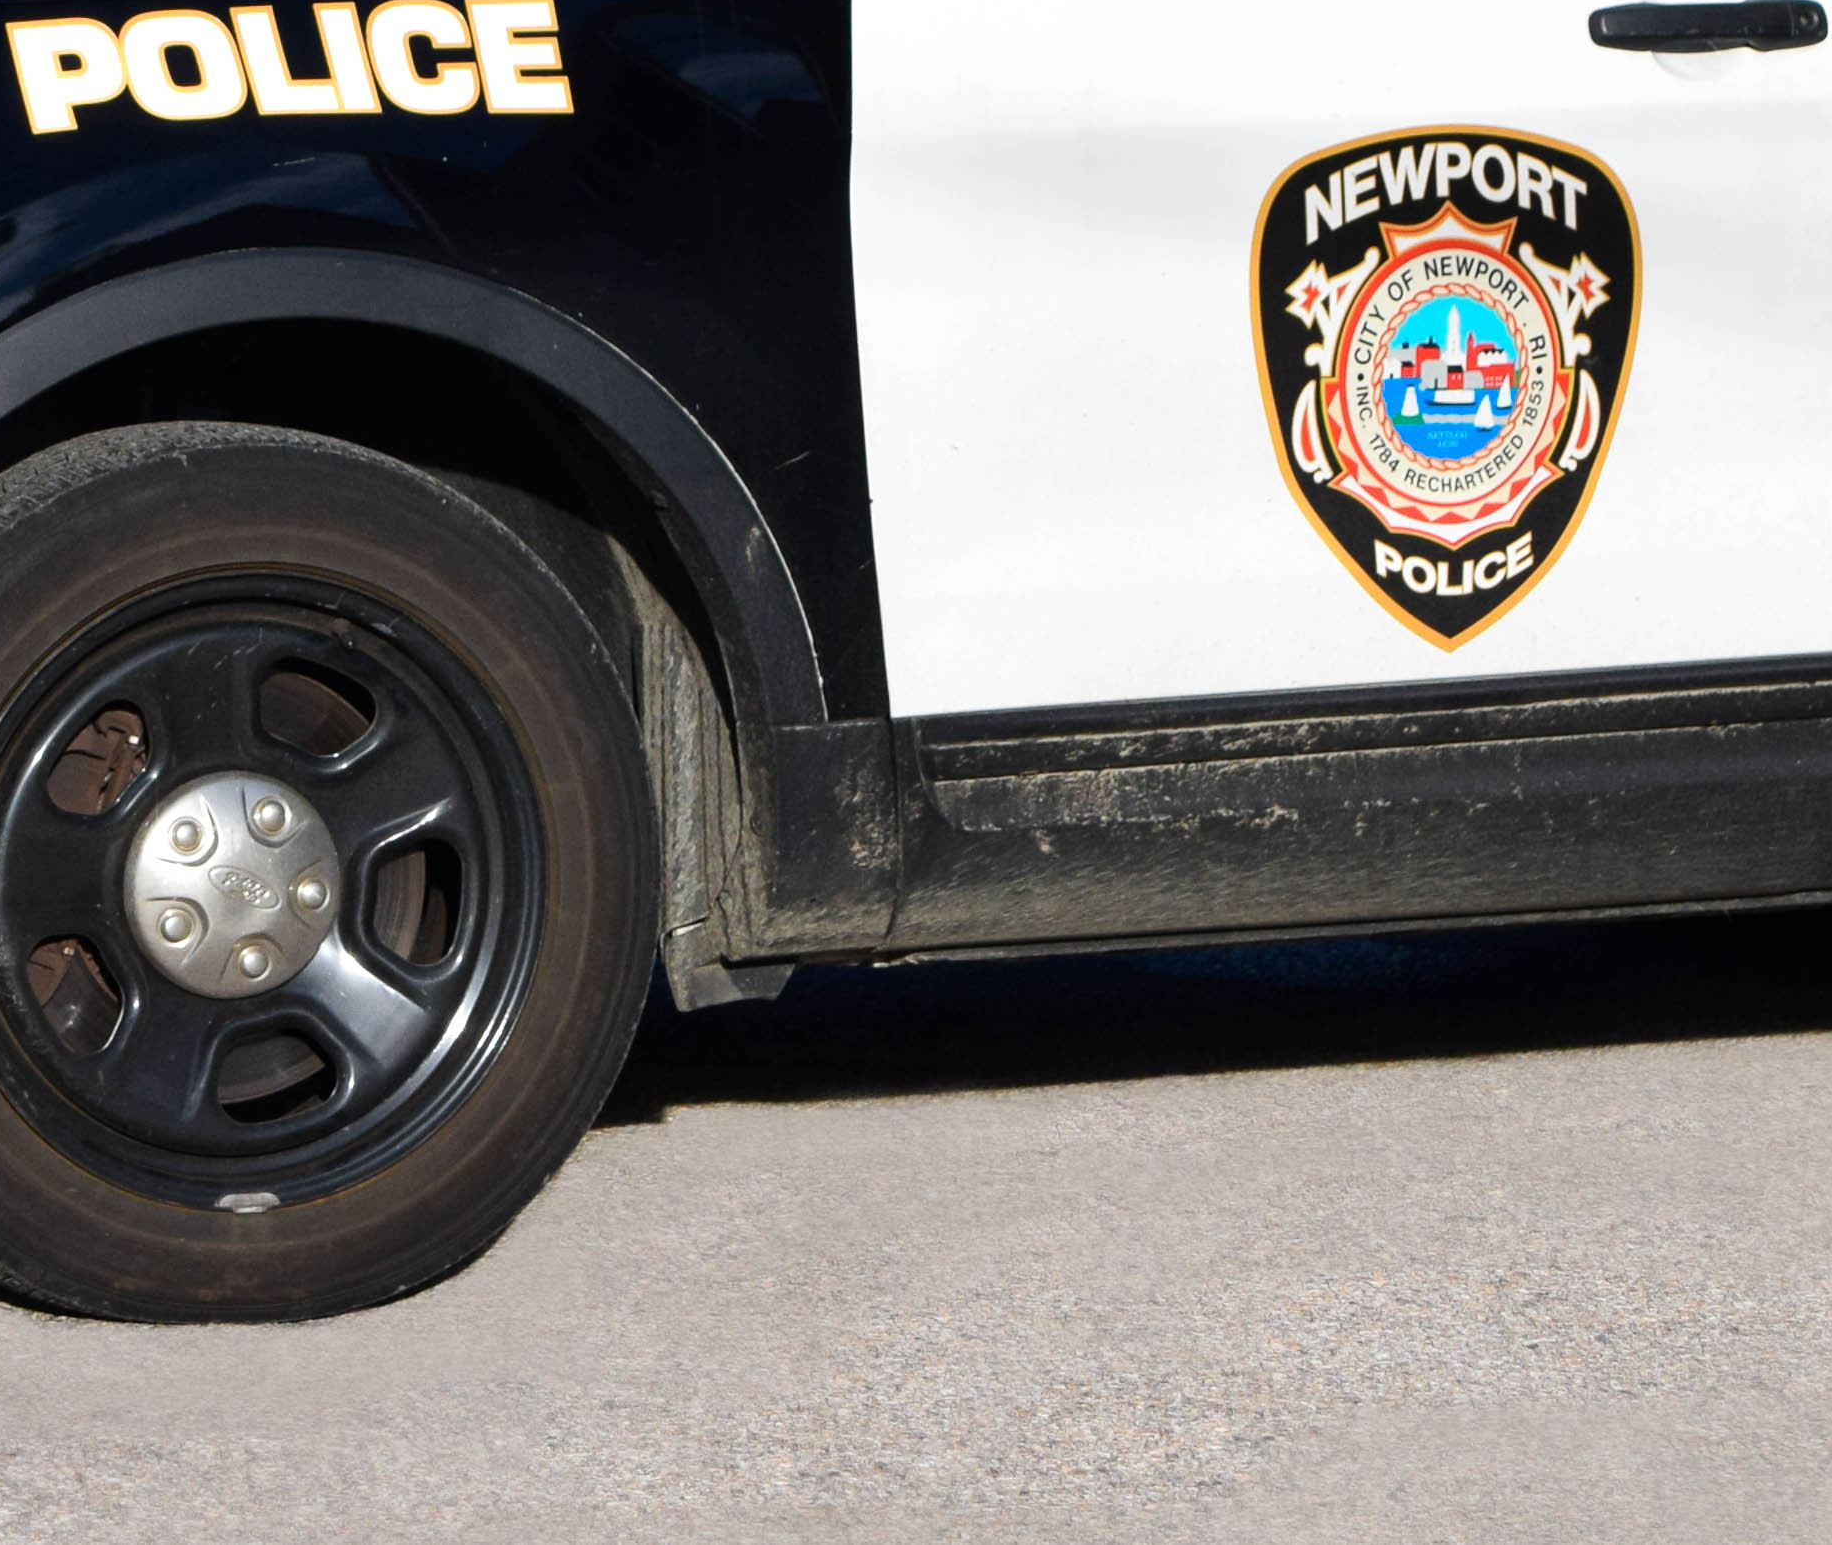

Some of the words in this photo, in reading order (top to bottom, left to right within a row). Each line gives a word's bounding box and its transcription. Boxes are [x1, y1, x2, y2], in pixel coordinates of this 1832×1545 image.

[1305, 142, 1588, 245] NEWPORT
[1354, 305, 1385, 365] CITY
[1387, 270, 1415, 302] OF
[1423, 255, 1529, 310] NEWPORT
[1529, 335, 1548, 360] RI
[1369, 434, 1400, 473] 1784
[1404, 434, 1524, 493] RECHARTERED
[1522, 379, 1545, 427] 1853
[1374, 531, 1534, 596] POLICE
